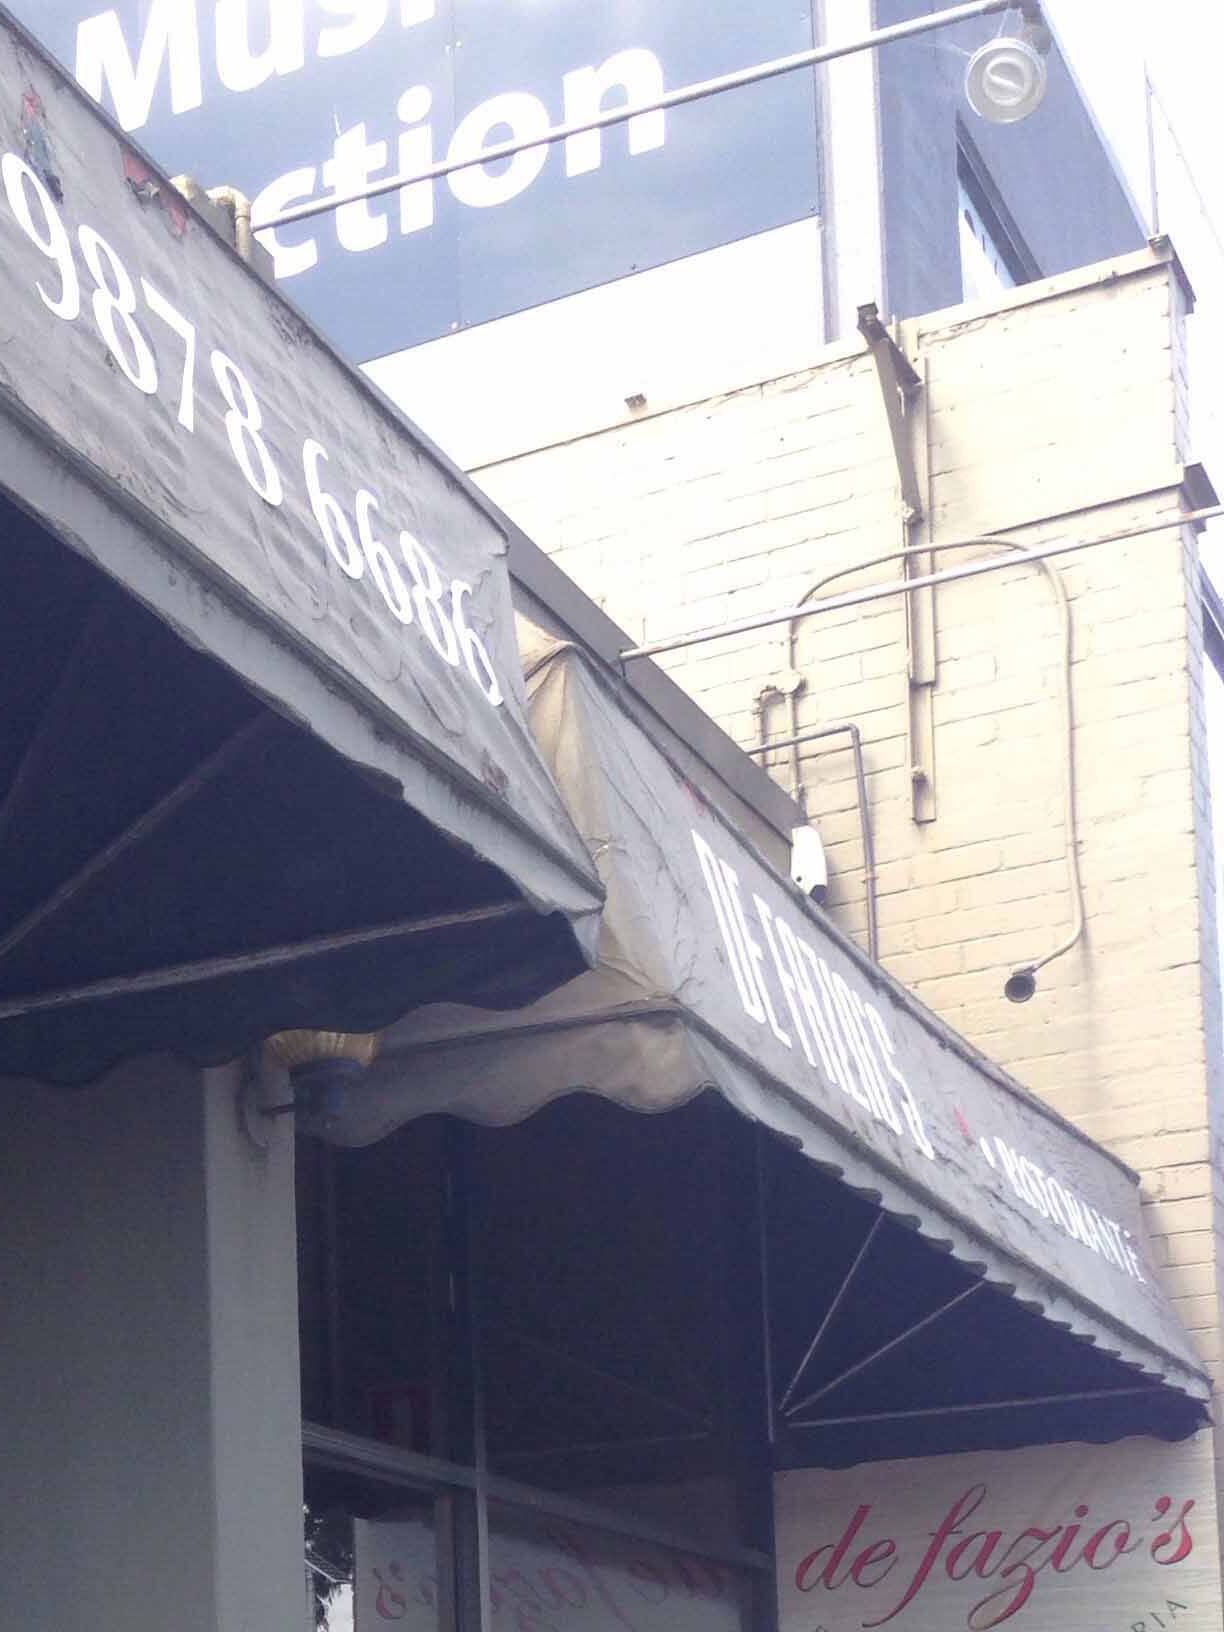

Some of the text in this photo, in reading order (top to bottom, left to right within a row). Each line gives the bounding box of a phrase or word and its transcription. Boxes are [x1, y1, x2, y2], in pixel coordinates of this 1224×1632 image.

[2, 152, 281, 506] 9878
[301, 438, 504, 706] 6686
[794, 1483, 1195, 1631] de fazio's
